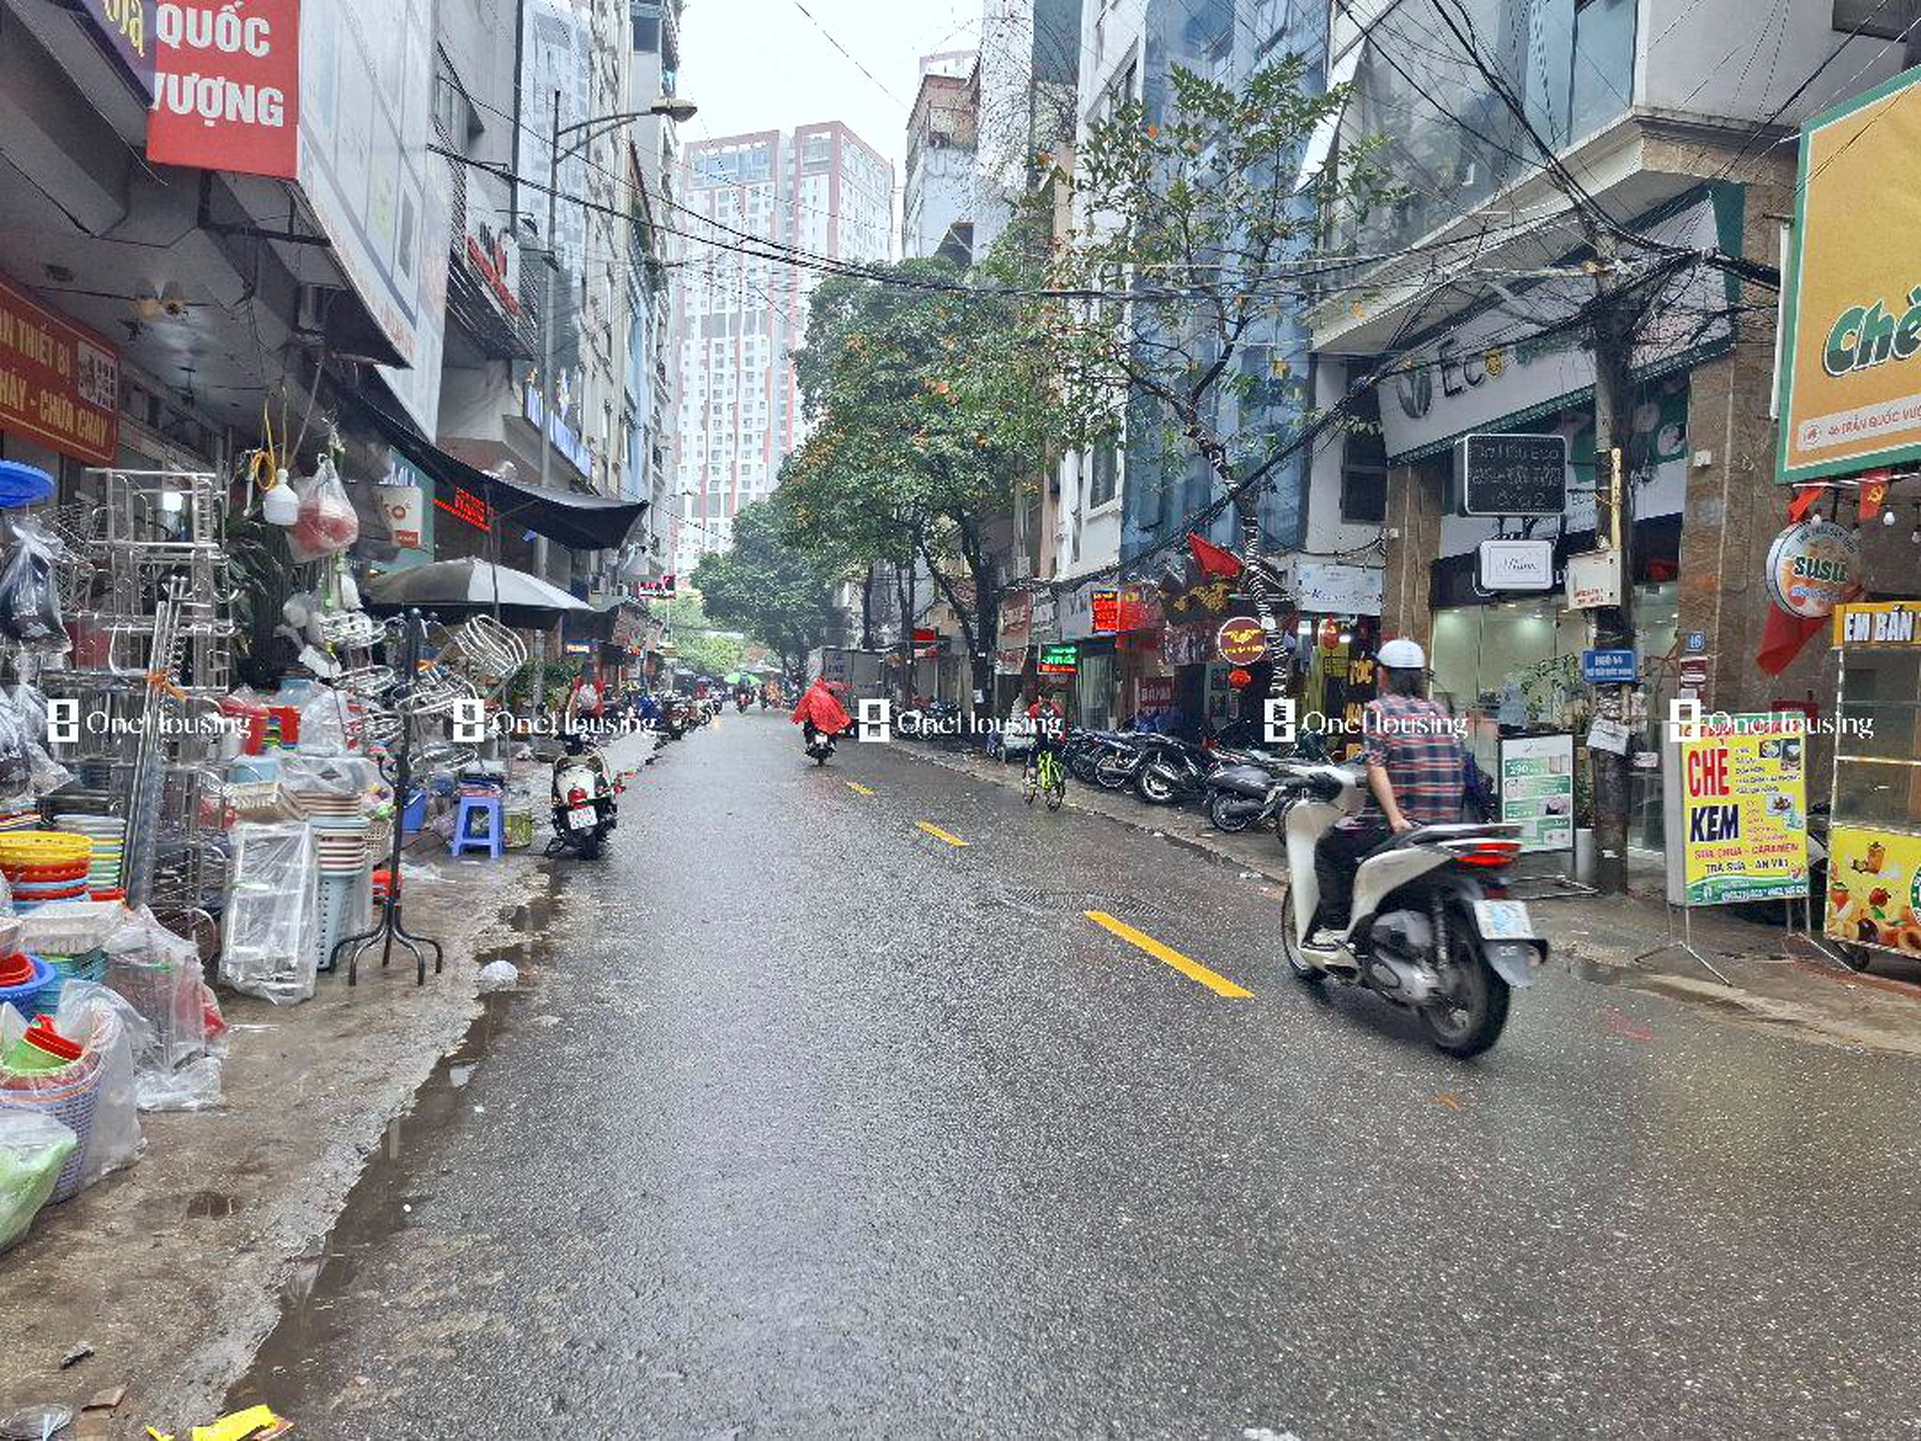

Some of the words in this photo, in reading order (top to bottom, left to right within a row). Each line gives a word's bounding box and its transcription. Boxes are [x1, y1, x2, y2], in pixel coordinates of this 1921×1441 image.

[156, 0, 270, 57] QUỐC
[1868, 407, 1900, 429] QUỐC
[1844, 612, 1871, 642] EM
[1875, 603, 1914, 642] BÁN
[1690, 803, 1739, 842] KEM
